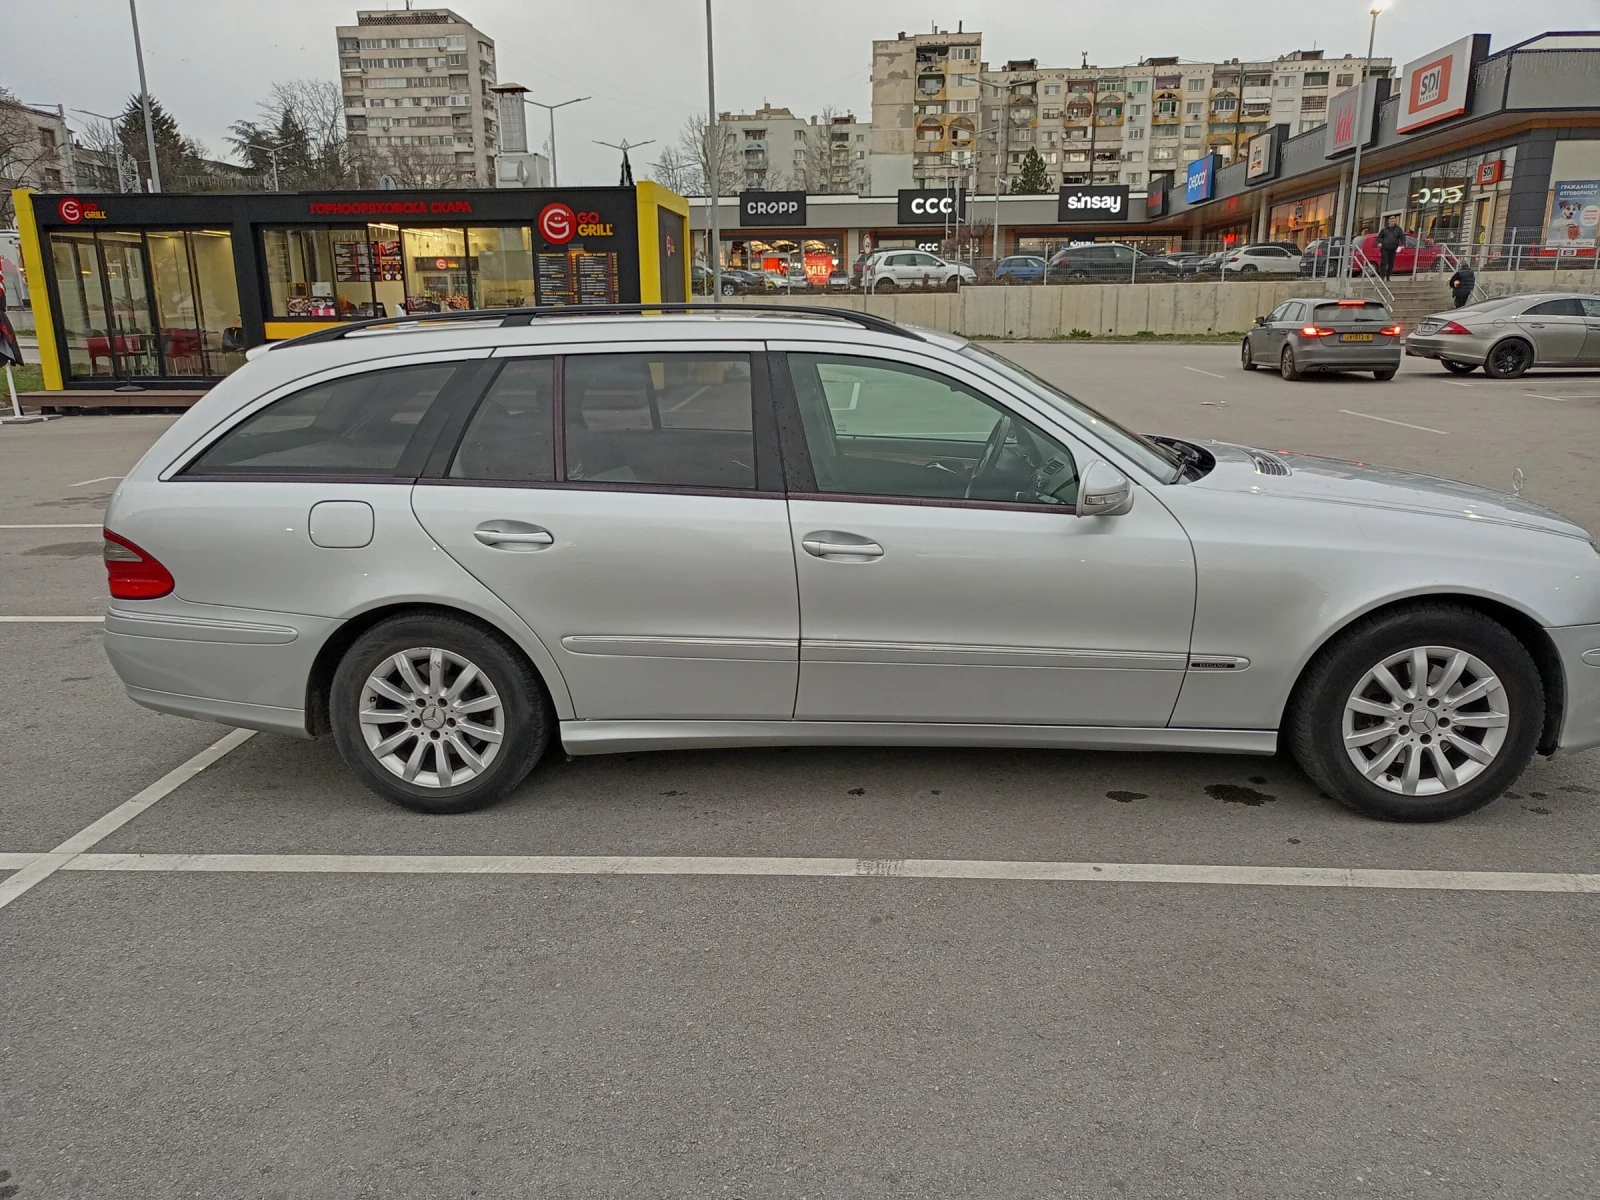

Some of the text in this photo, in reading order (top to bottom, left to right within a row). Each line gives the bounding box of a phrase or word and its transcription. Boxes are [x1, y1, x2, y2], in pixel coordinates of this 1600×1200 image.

[1420, 69, 1440, 96] SDI
[1187, 169, 1207, 192] pepco
[310, 201, 472, 214] ГОРНООРЯХОВСКА СКАРА
[747, 201, 798, 214] CROPP
[911, 197, 953, 214] CCC
[1067, 192, 1121, 213] sinsay
[84, 211, 106, 219] GRILL
[577, 211, 600, 224] GO
[577, 223, 613, 236] GRILL
[918, 243, 939, 251] CCC
[806, 265, 828, 276] SALE
